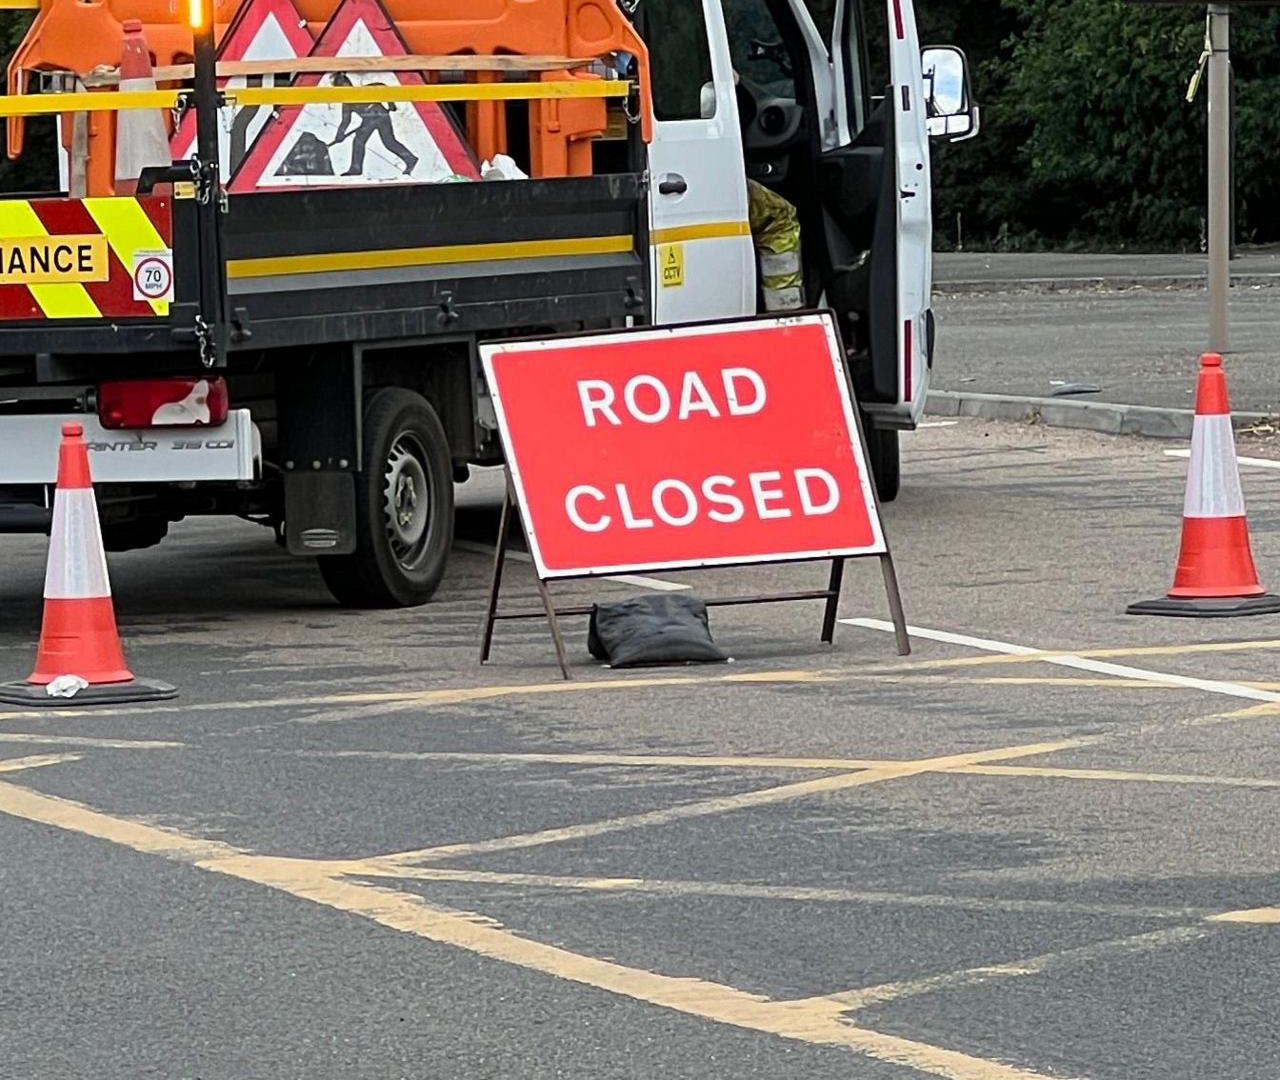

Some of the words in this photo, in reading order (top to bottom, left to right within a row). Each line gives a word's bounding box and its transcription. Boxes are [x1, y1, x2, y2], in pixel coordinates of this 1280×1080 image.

[145, 269, 162, 282] 70
[576, 366, 767, 428] ROAD
[564, 467, 841, 533] CLOSED
